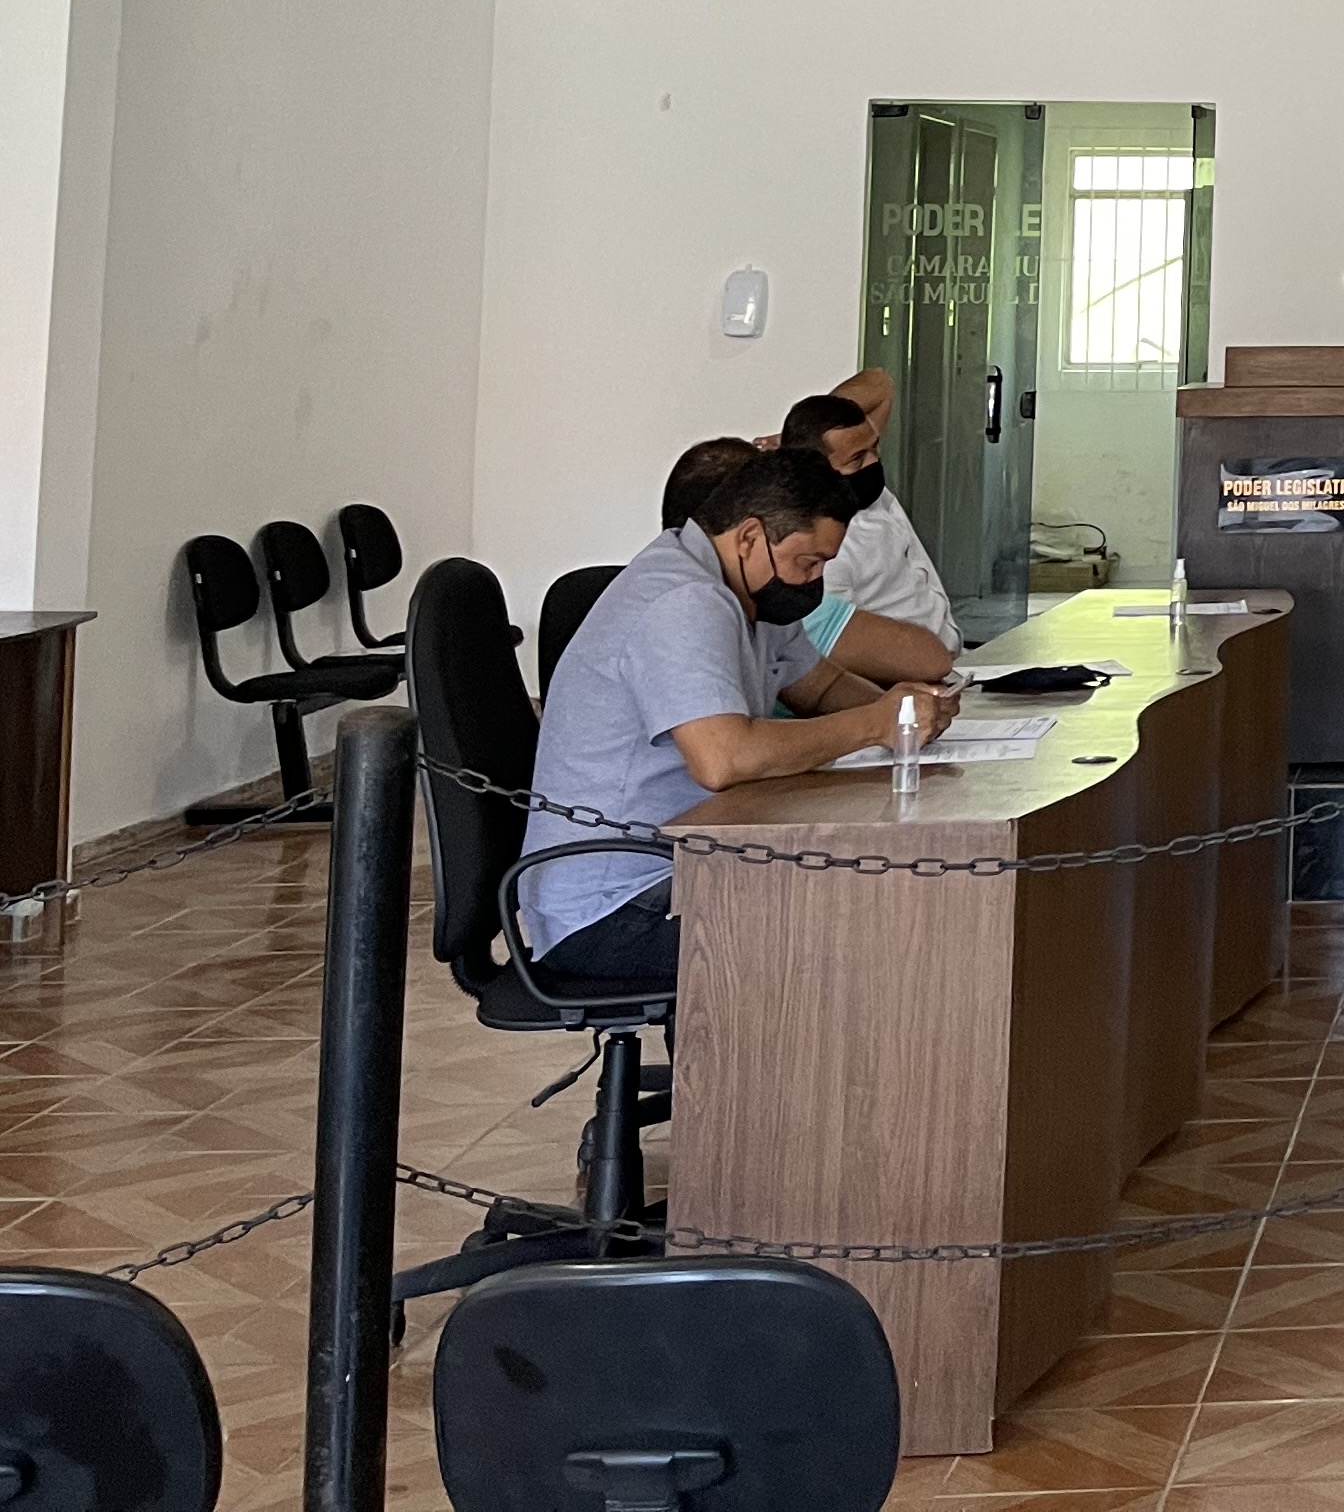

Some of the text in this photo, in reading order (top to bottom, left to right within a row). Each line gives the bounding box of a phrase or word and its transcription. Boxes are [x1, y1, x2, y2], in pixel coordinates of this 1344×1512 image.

[882, 203, 985, 237] PODER
[1223, 479, 1272, 496] PODER
[1227, 499, 1245, 512] SÃO
[1246, 500, 1280, 512] MIGUEL
